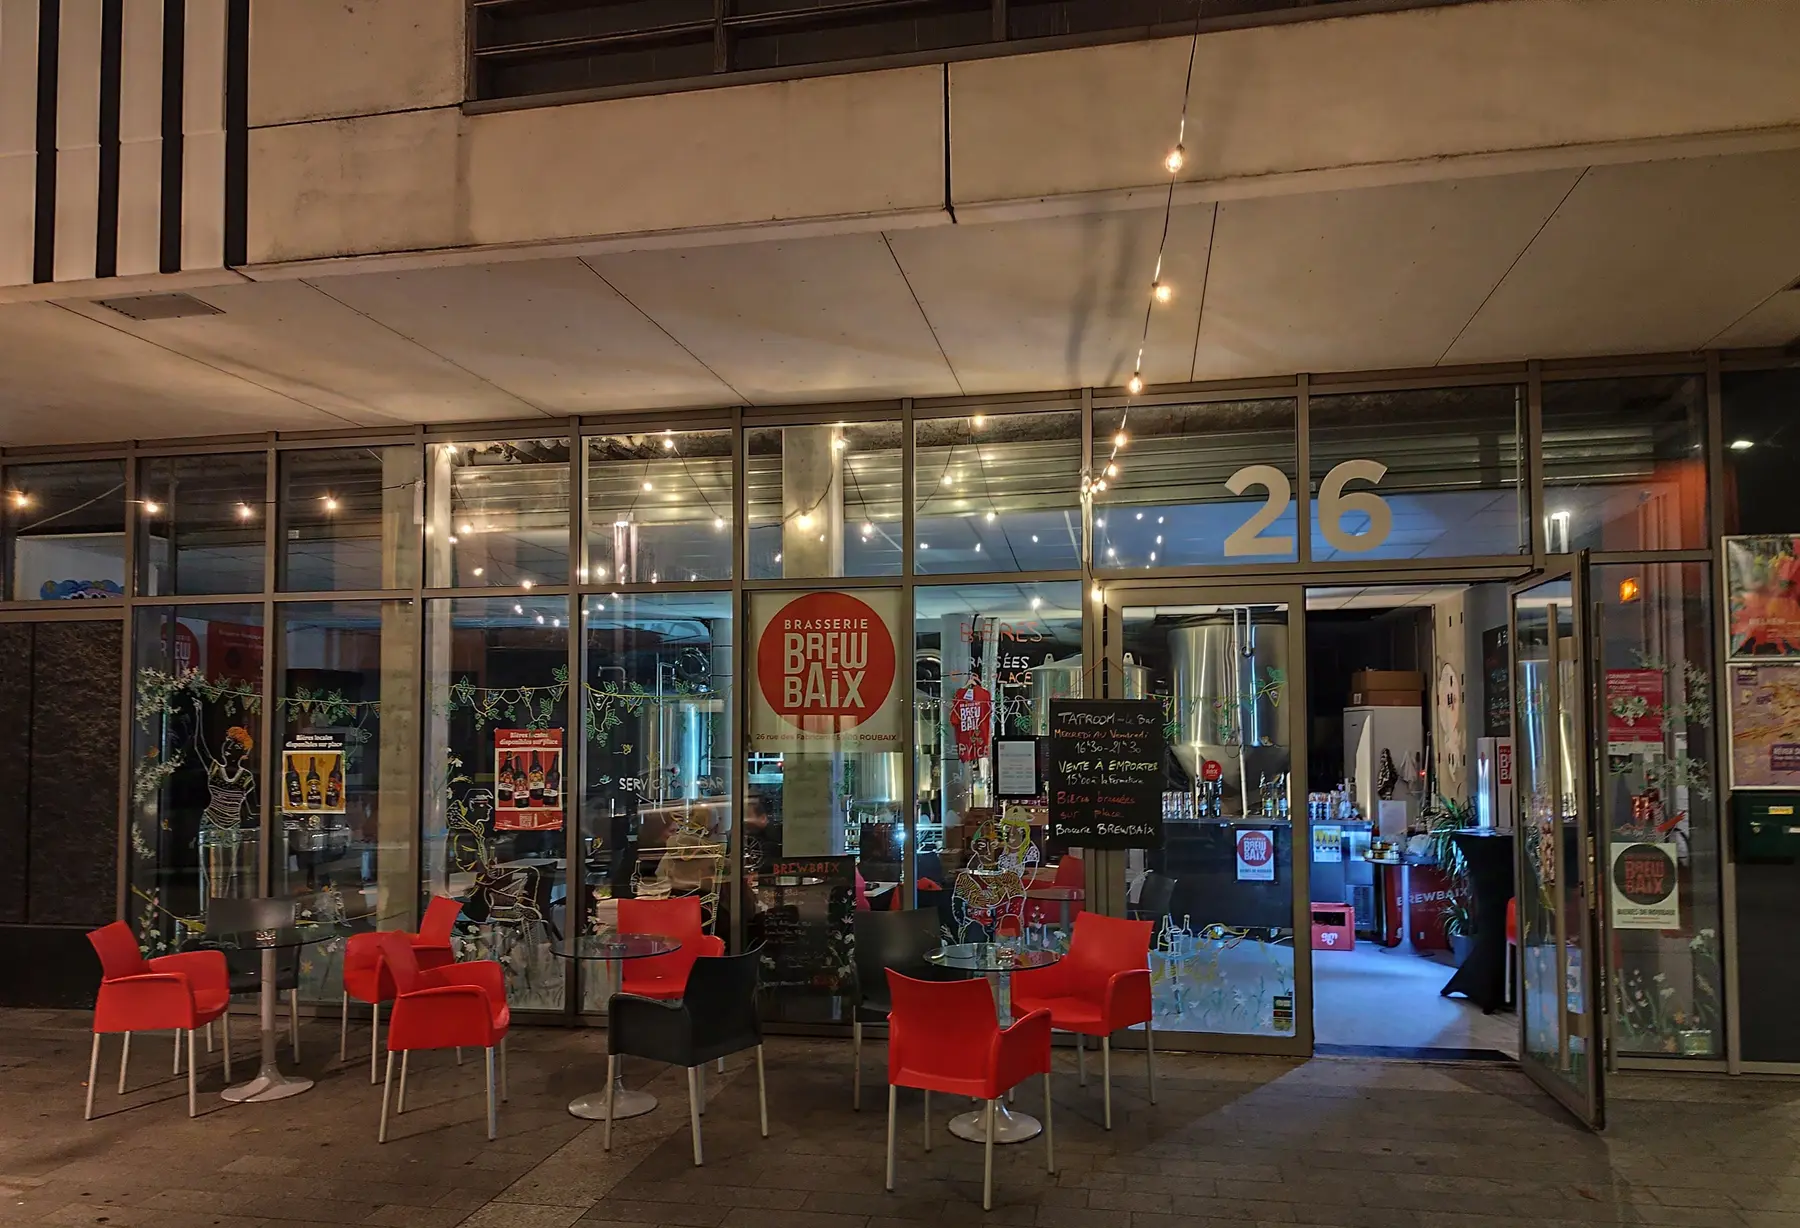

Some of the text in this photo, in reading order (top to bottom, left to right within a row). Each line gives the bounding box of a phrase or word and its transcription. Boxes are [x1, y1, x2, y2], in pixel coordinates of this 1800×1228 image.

[1224, 459, 1392, 557] 26
[784, 619, 868, 630] BRASSERIE
[784, 632, 868, 674] BREW
[963, 653, 1029, 669] RASÉES
[1058, 712, 1116, 725] TAPROOM
[1137, 714, 1156, 725] Bar
[1058, 761, 1090, 773] VENTE
[1108, 760, 1158, 772] EMPORTER
[619, 777, 667, 791] SERVCE
